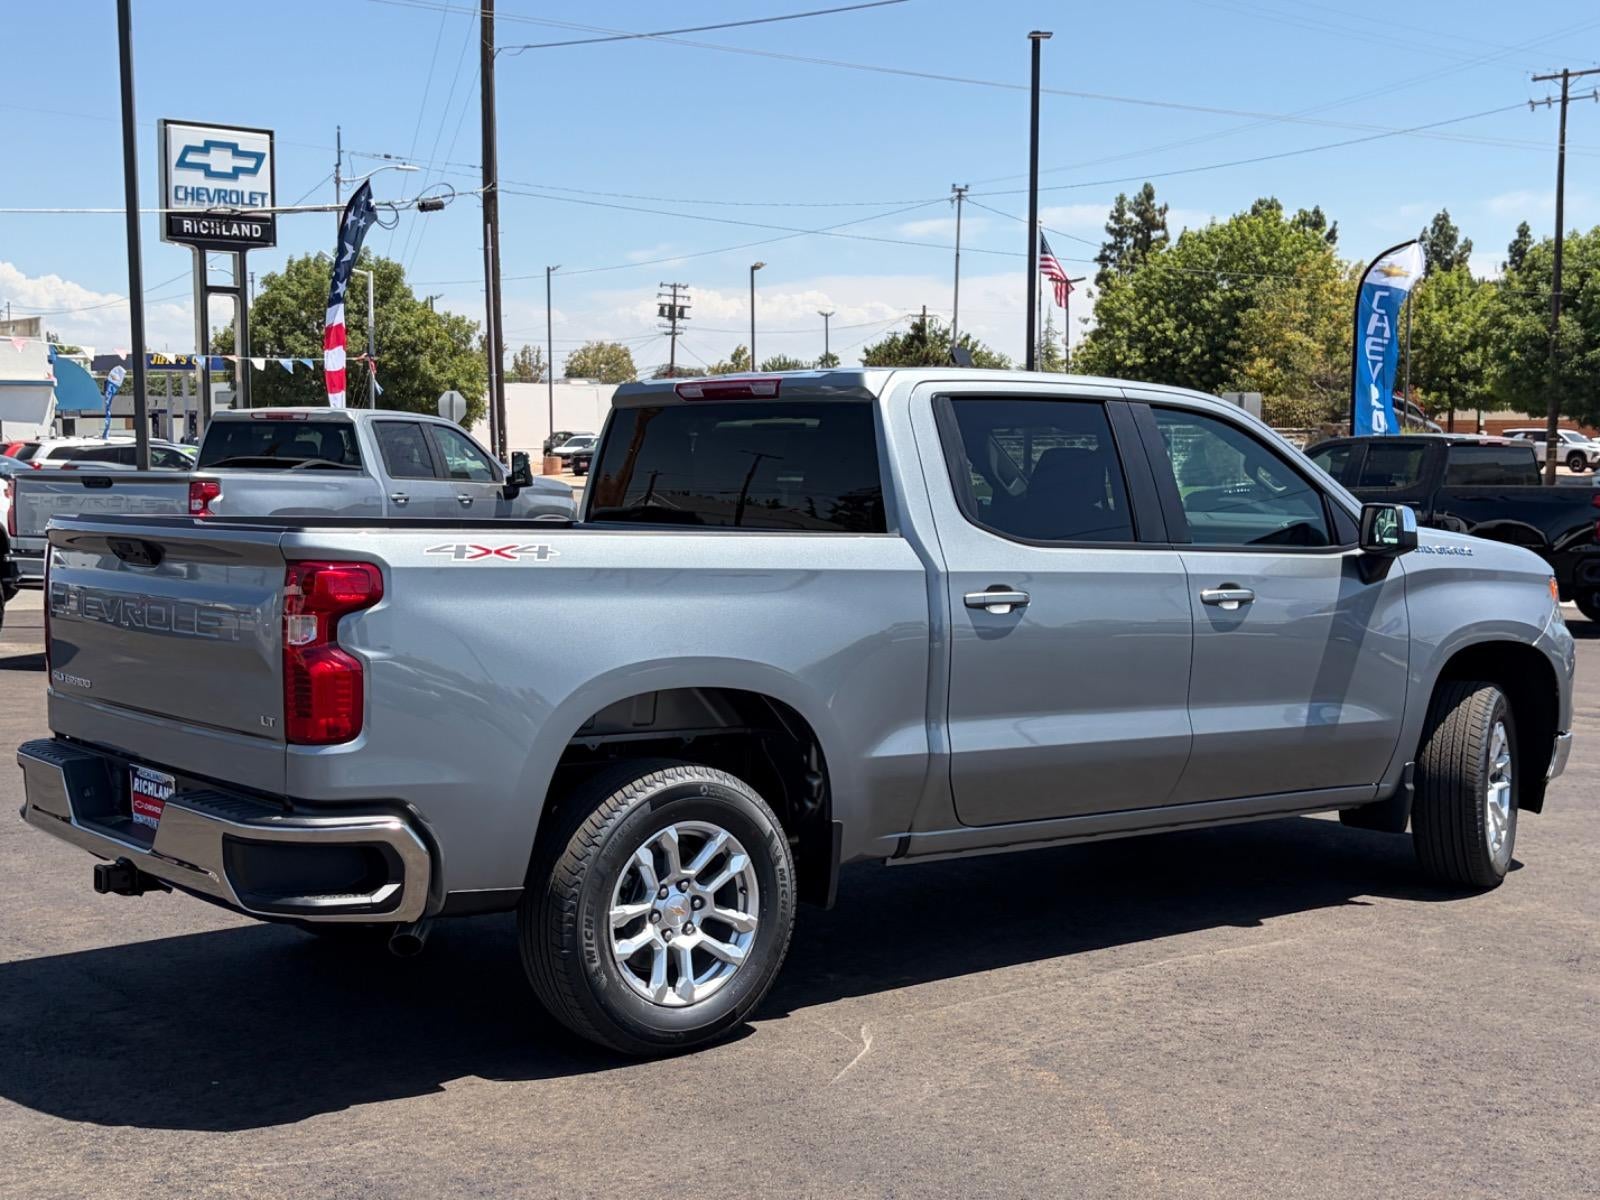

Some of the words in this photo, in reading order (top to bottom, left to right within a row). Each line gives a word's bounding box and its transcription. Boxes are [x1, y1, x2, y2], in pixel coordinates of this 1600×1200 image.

[174, 185, 268, 207] CHEVROLET
[182, 220, 262, 237] RICHLAND
[260, 715, 276, 728] LT
